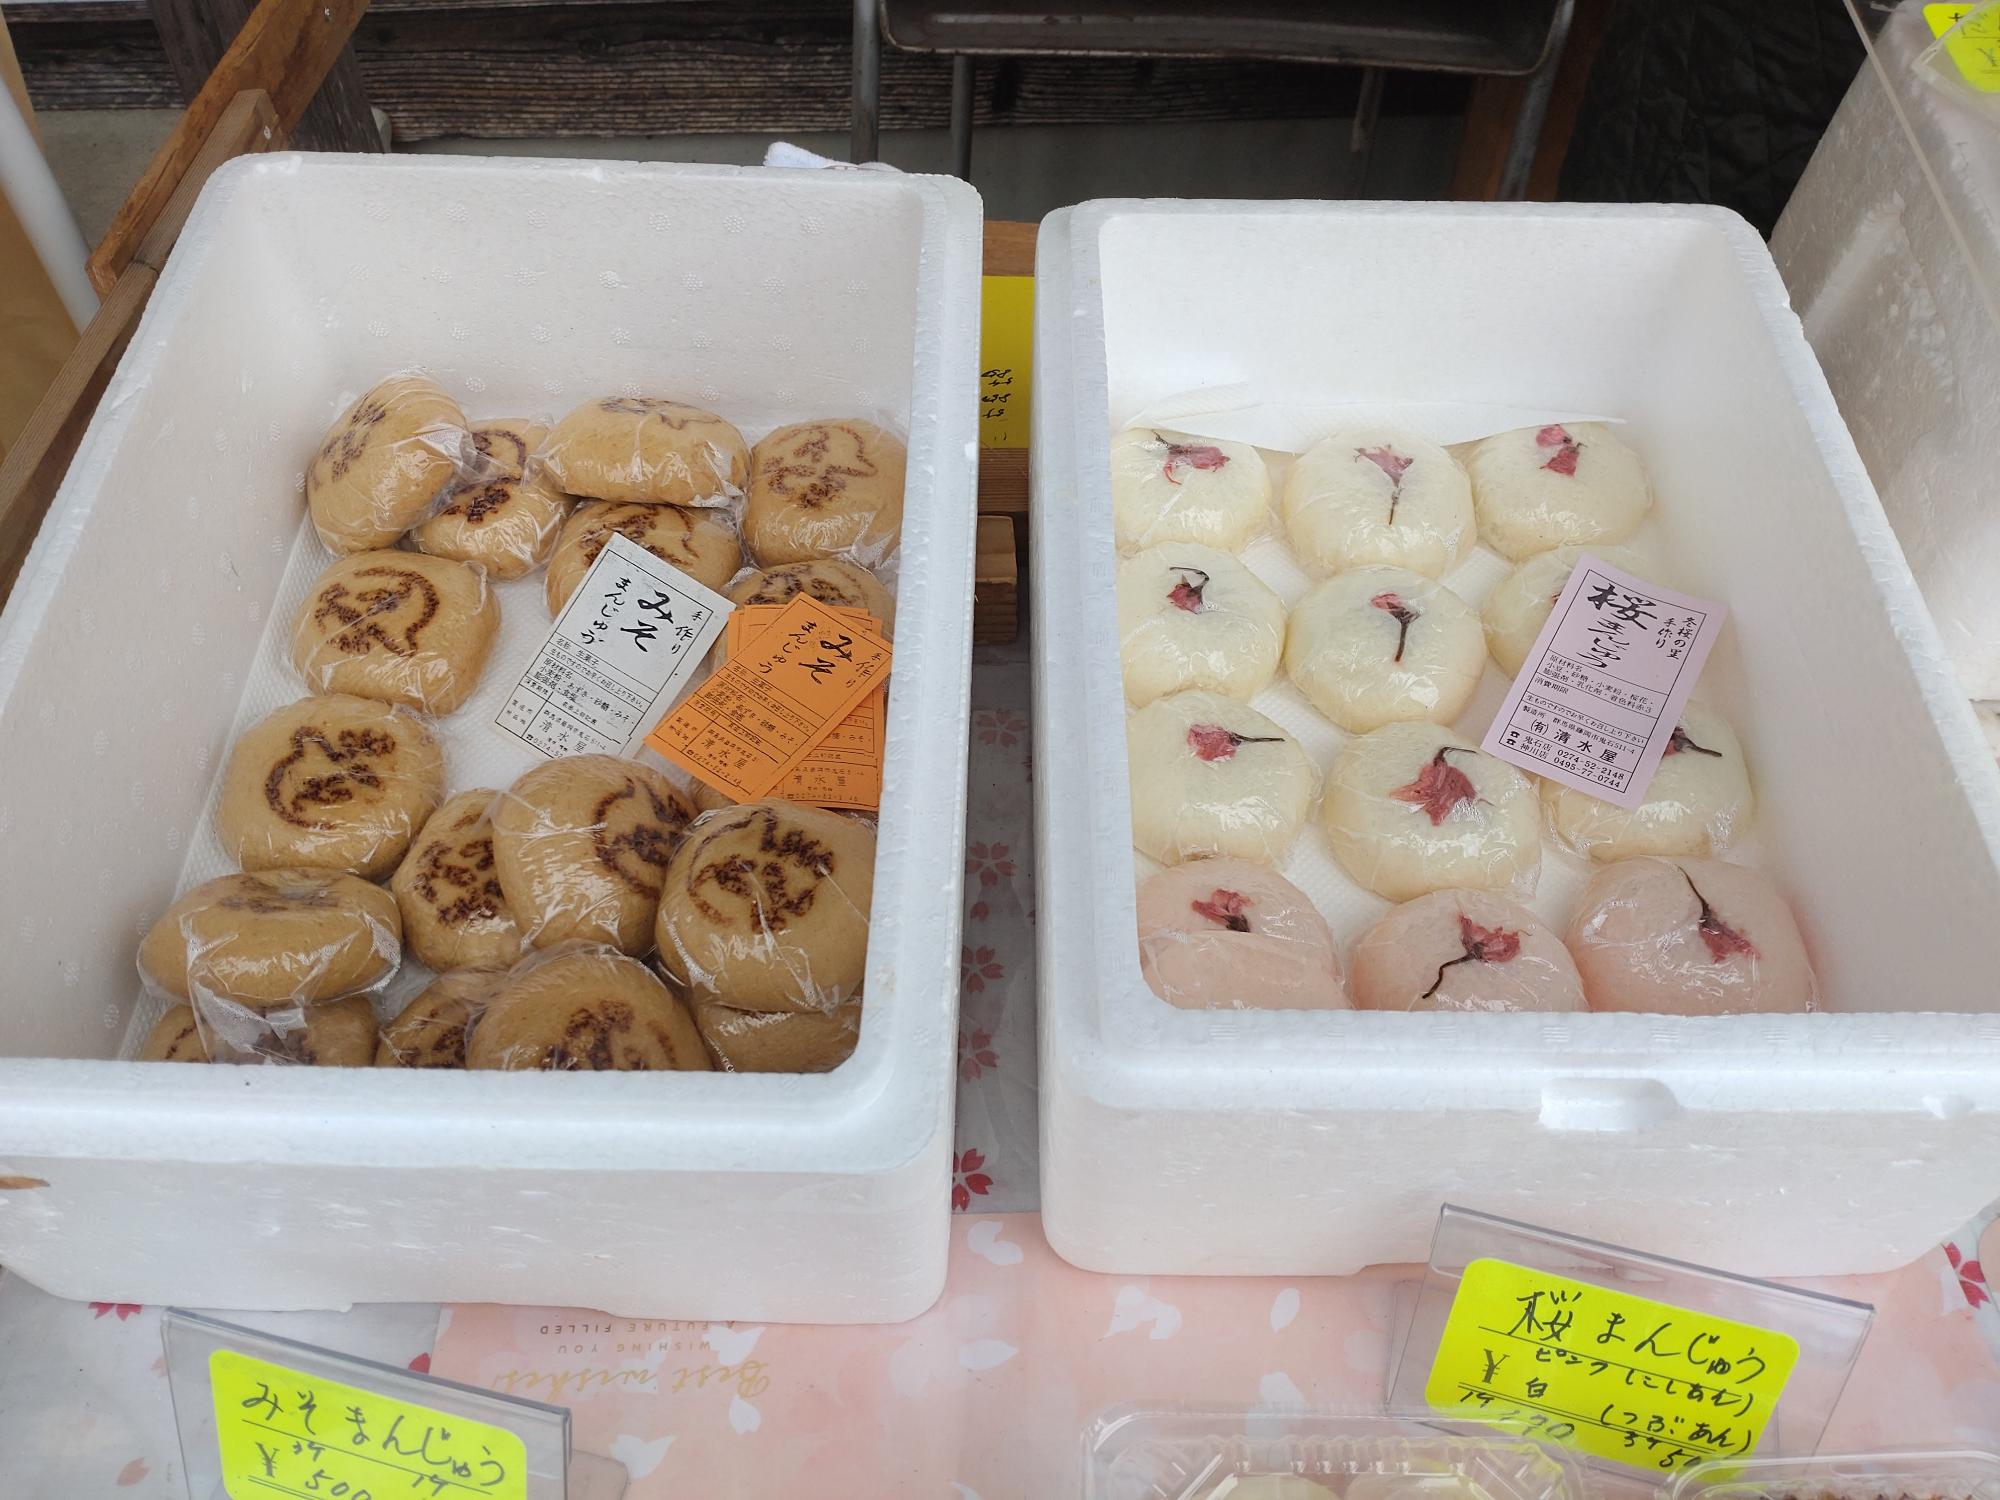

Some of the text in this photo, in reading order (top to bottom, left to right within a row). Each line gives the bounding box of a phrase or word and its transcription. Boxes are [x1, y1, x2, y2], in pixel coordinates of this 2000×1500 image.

[581, 577, 632, 644] まんじゅう
[620, 590, 674, 652] みそ
[672, 611, 702, 654] 手作り
[759, 621, 817, 674] まんじゅう
[1656, 618, 1676, 648] 手作り
[1667, 618, 1697, 660] 冬桜の里
[544, 658, 573, 680] 原材料名
[576, 650, 599, 666] 生菓子
[798, 634, 853, 684] みそ
[846, 653, 882, 688] 手作り
[1550, 655, 1582, 672] 原材料名
[1535, 678, 1569, 694] 消費期限
[1524, 706, 1546, 718] 製造所
[1524, 736, 1624, 780] 鬼石店 0274-52-2148
[1531, 719, 1618, 764] (有) 清水屋
[1520, 743, 1620, 788] 神川店 0495-77-0744
[540, 1323, 611, 1335] FILLED
[627, 1321, 709, 1332] FUTURE
[558, 1340, 711, 1355] WISHING YOU
[672, 1360, 770, 1398] Best
[1526, 1377, 1548, 1399] 白
